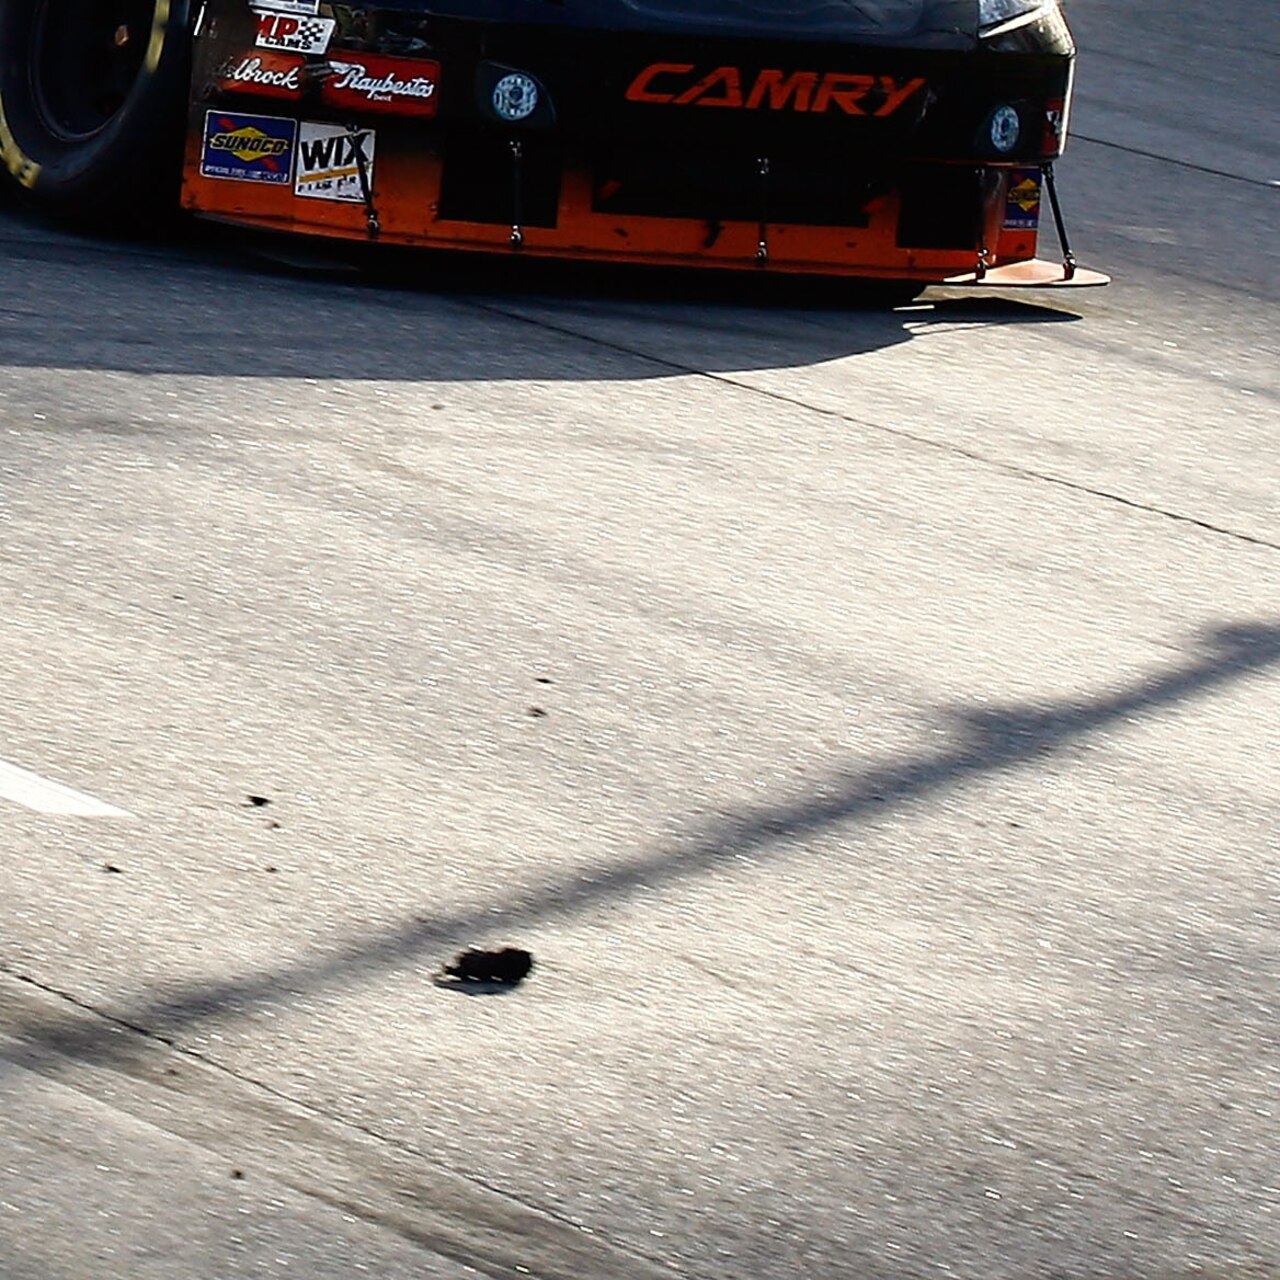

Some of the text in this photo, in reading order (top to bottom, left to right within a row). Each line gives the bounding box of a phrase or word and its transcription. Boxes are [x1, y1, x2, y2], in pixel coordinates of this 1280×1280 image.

[329, 61, 435, 99] Raybestos
[625, 62, 928, 117] CAMRY
[211, 134, 287, 155] SUNOCO
[300, 131, 372, 172] WIX
